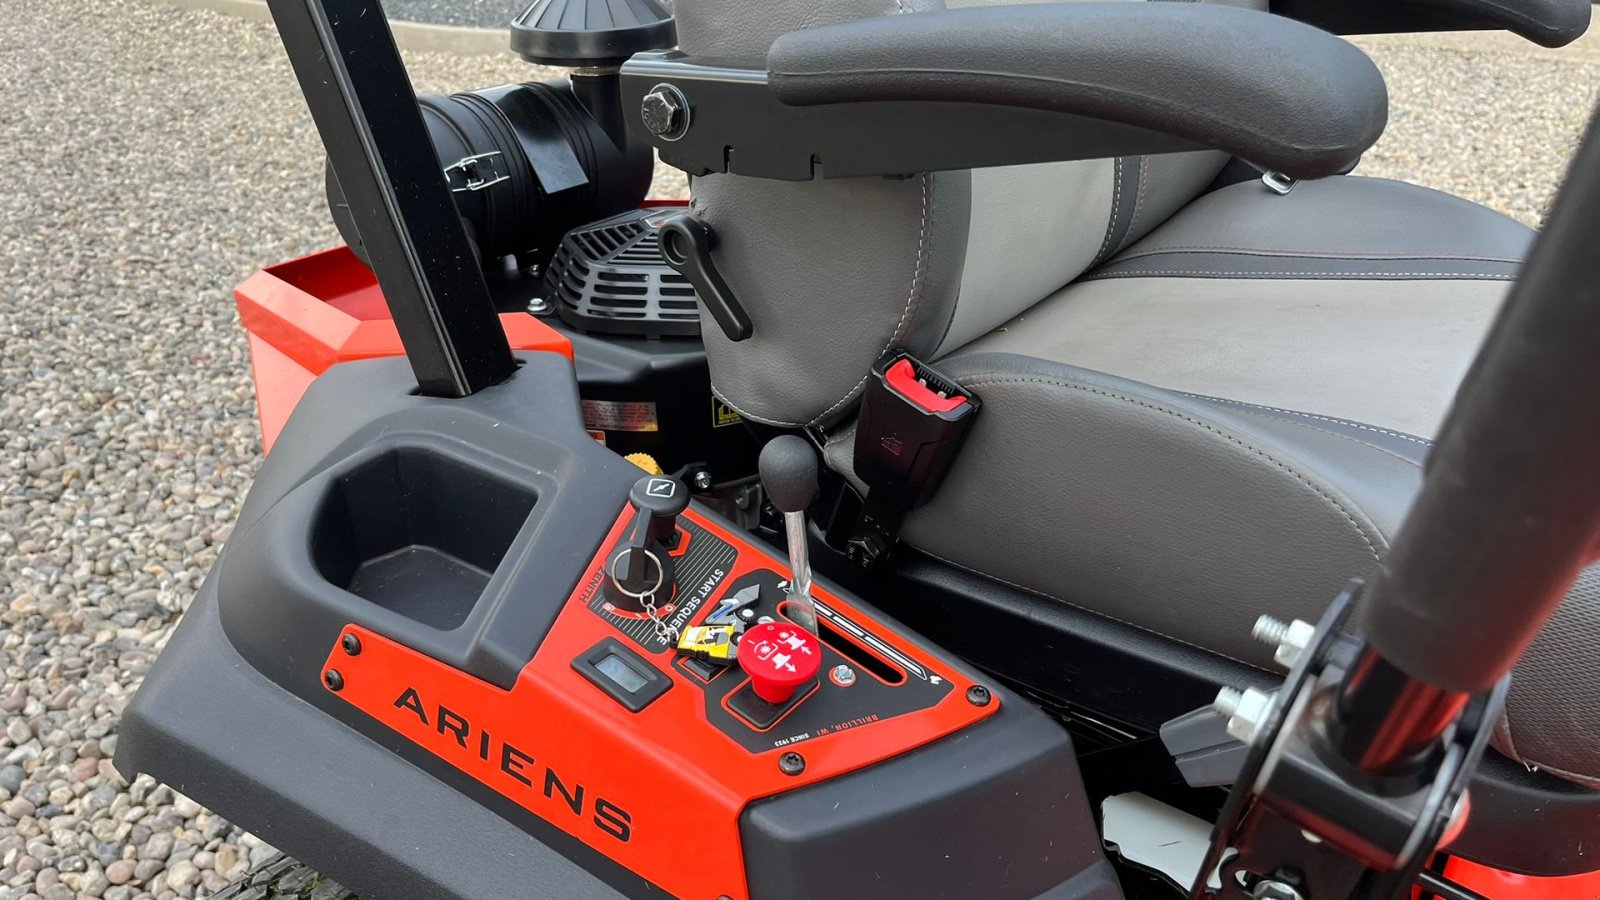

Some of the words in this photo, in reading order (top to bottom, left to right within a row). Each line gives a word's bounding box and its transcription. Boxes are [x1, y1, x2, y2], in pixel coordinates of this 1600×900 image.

[698, 568, 724, 598] START
[816, 727, 830, 737] WI
[831, 714, 879, 732] BRILLION,
[789, 733, 810, 743] SINCE
[393, 687, 632, 842] ARIENS
